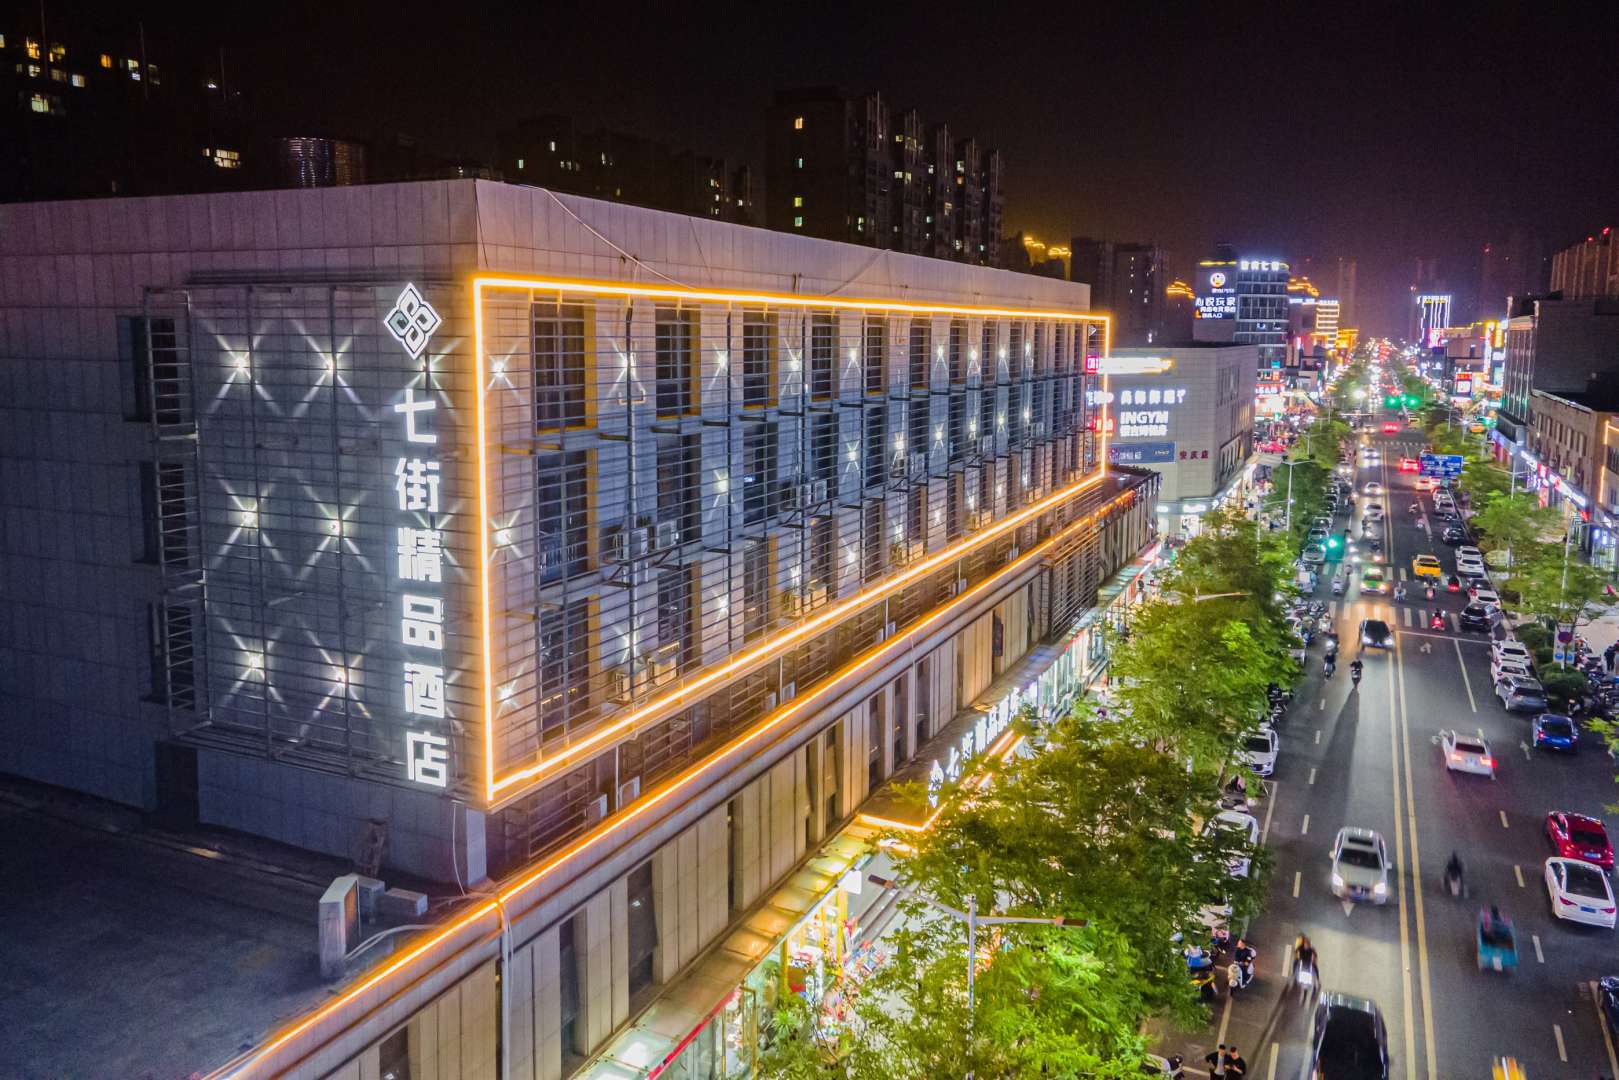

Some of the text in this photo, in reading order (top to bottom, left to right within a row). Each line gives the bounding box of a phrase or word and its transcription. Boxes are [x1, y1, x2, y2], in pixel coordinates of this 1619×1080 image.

[1120, 411, 1169, 425] INGYM
[394, 388, 447, 788] 七街精品酒店
